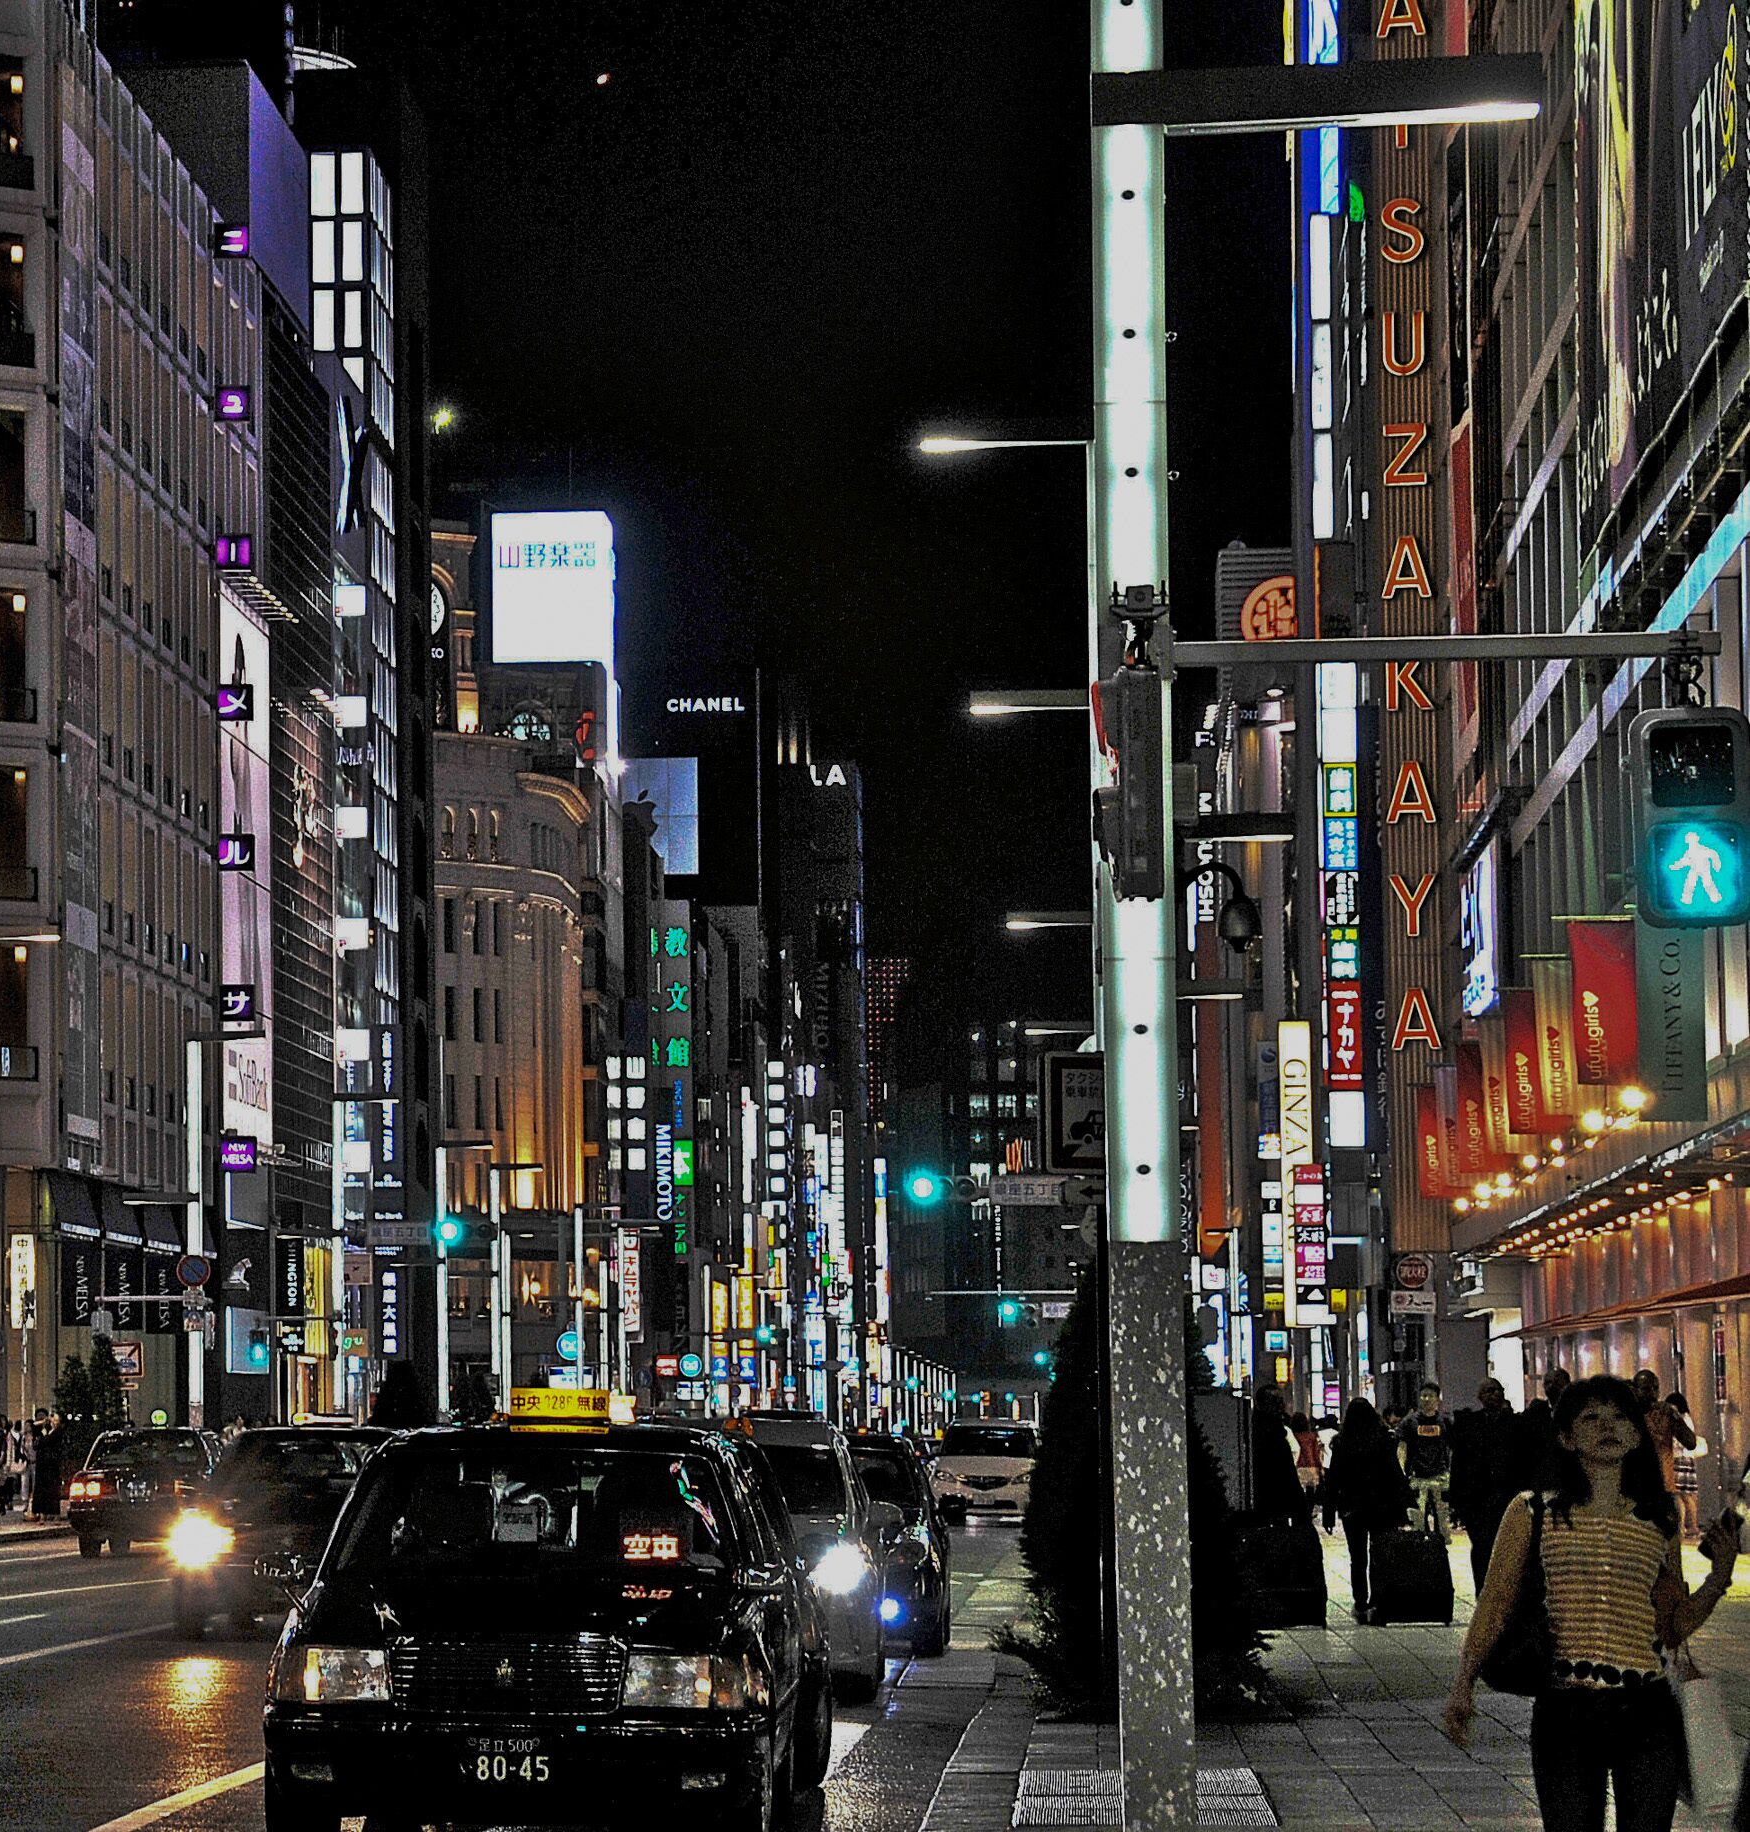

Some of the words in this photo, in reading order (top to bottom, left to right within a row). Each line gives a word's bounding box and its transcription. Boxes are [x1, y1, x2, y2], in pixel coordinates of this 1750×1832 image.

[1376, 0, 1442, 1051] ASUZAKAYA
[665, 696, 746, 714] CHANEL
[664, 926, 690, 1068] 教文館
[1283, 1058, 1309, 1156] GINZA
[221, 1153, 254, 1165] MELSA
[227, 1143, 248, 1153] NEW
[655, 1123, 673, 1221] MIKIMOTO
[511, 1394, 541, 1412] 中央
[576, 1394, 607, 1412] 無線
[623, 1533, 679, 1561] 空車
[476, 1755, 550, 1782] 80-45
